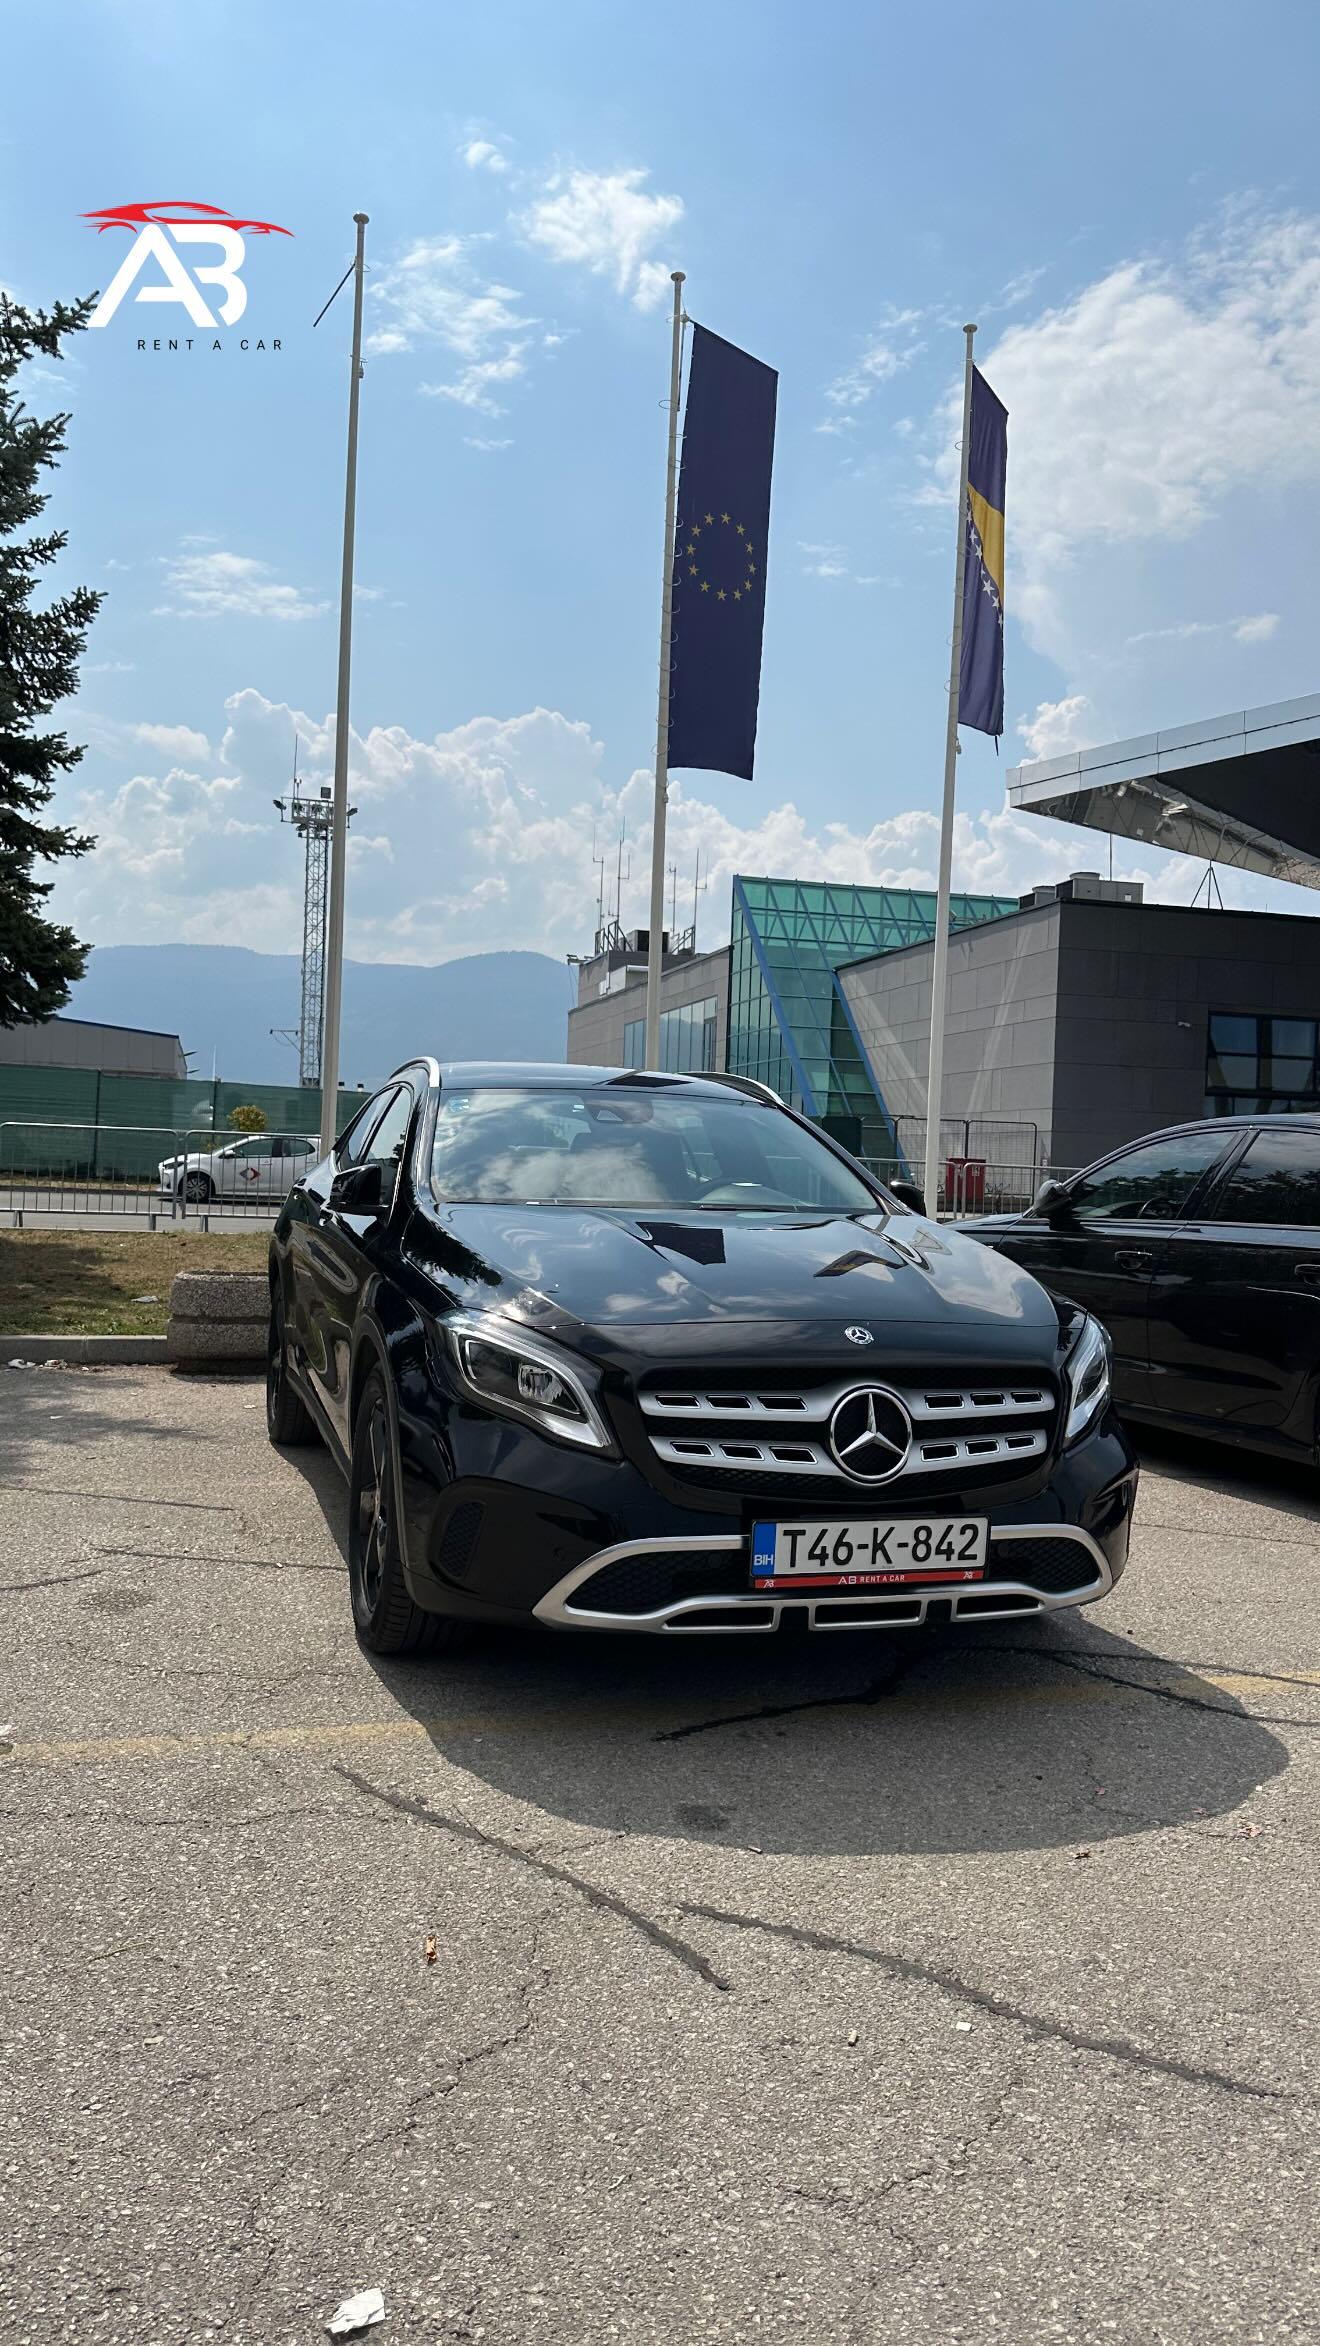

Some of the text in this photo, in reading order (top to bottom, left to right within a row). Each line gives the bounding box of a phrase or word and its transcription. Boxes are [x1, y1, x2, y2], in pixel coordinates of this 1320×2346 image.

[783, 1523, 980, 1568] T46-K-842
[753, 1554, 775, 1567] BIH
[838, 1574, 905, 1585] AB RENT A CAR
